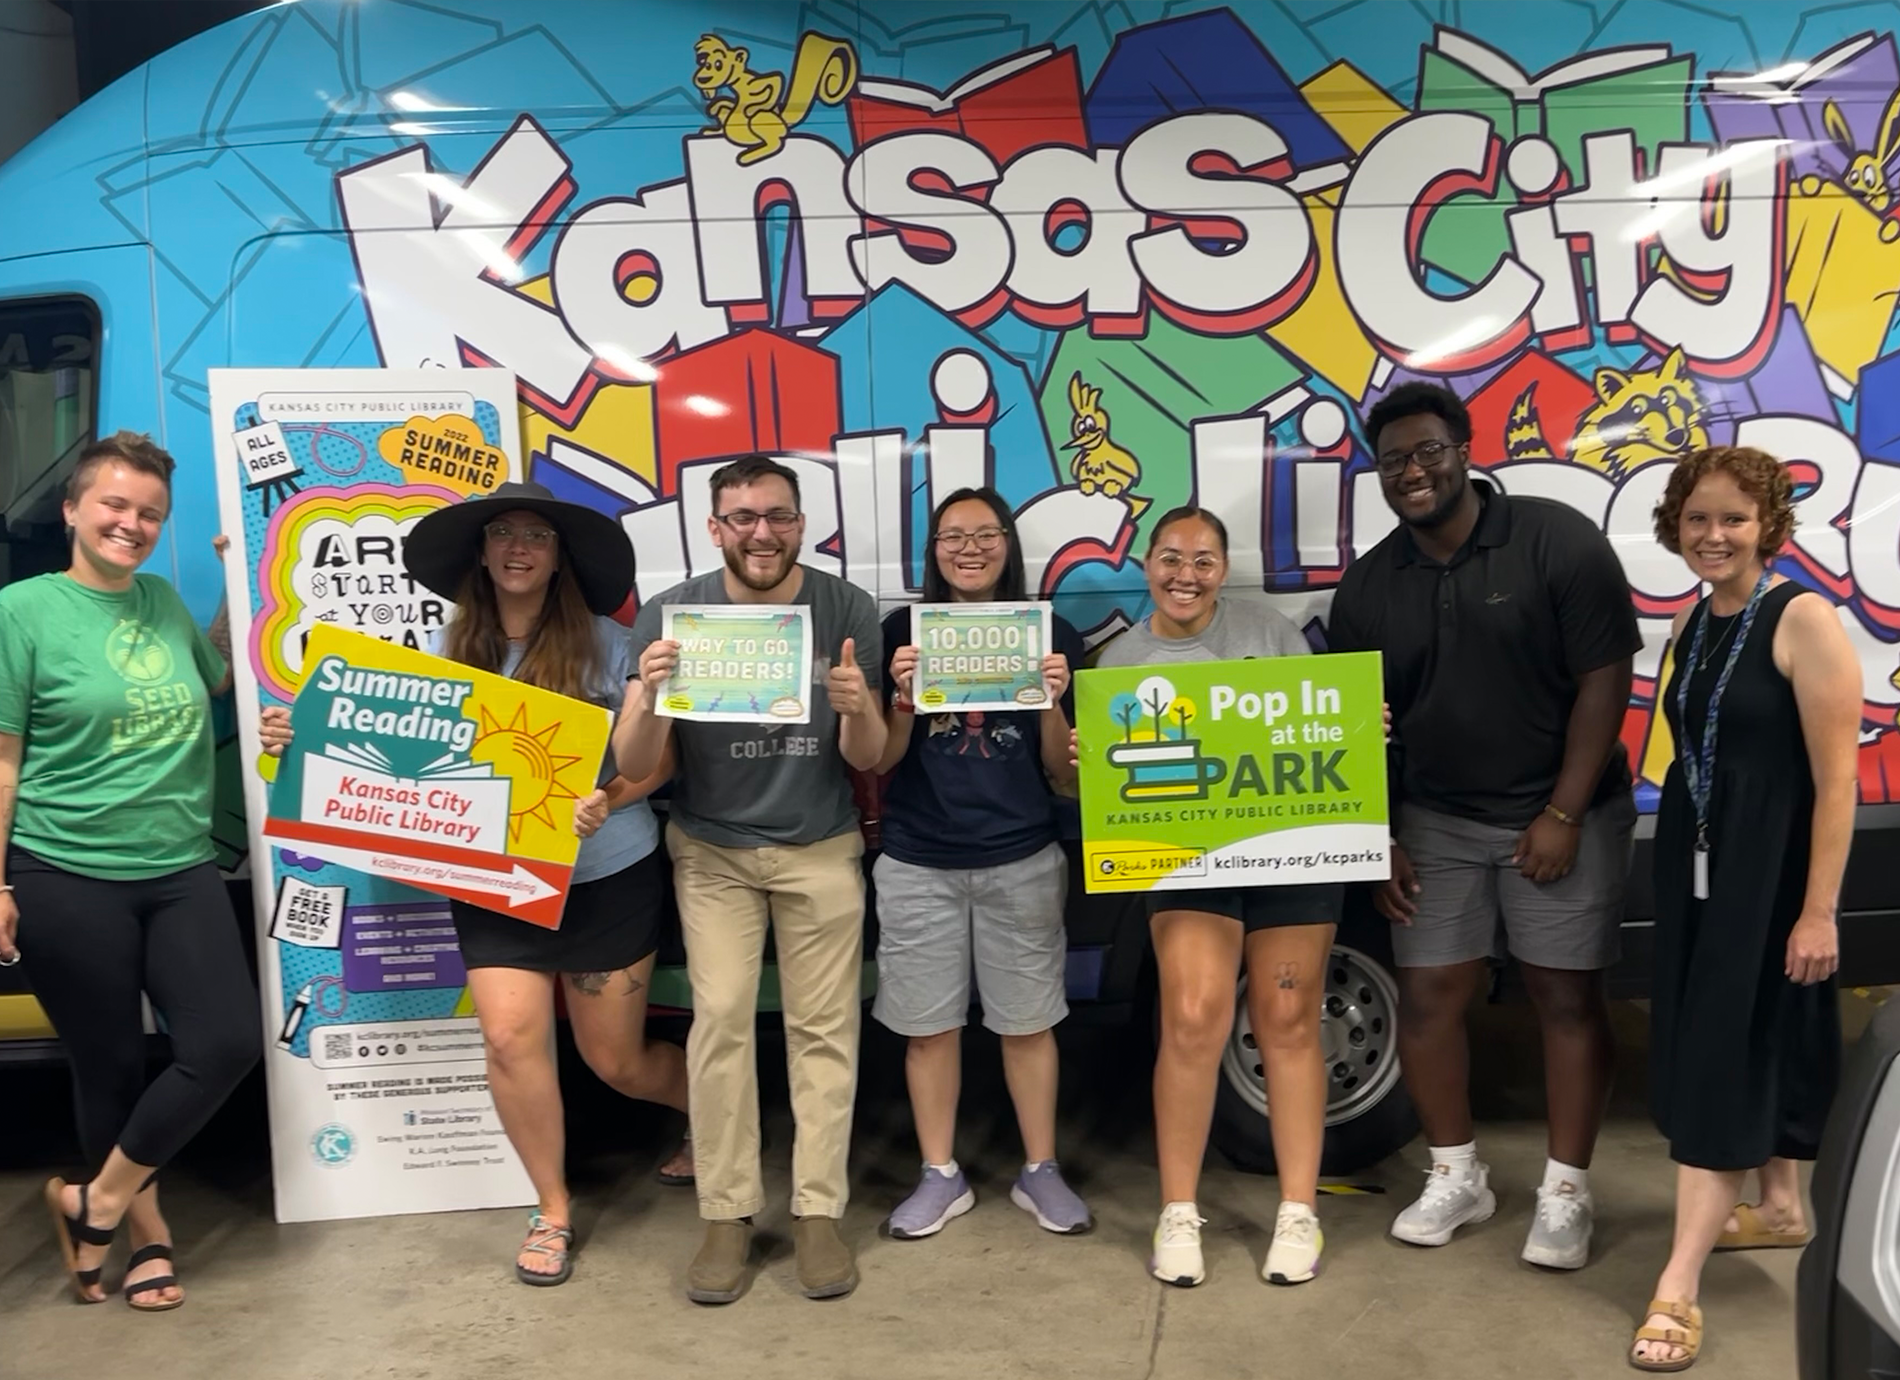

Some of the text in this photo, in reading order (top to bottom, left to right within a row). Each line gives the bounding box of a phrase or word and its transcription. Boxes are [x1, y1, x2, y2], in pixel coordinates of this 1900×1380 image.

[333, 109, 1790, 408] Kansas City
[269, 401, 463, 412] KANSAS CITY PUBLIC LIBRARY
[247, 434, 275, 451] ALL
[443, 428, 469, 442] 2022
[249, 451, 288, 472] AGES
[404, 429, 500, 471] SUMMER
[400, 448, 496, 489] READING
[313, 533, 407, 568] AR
[680, 637, 726, 655] WAY
[733, 638, 758, 656] TO
[679, 660, 795, 681] READERS!
[928, 654, 1023, 675] READERS
[317, 659, 471, 709] Summer
[125, 682, 193, 716] SEED
[1210, 679, 1341, 728] Pop In
[327, 696, 477, 753] Reading
[1270, 721, 1344, 746] at the
[730, 737, 819, 760] COLLEGE
[1200, 749, 1350, 800] PARK
[339, 776, 473, 818] Kansas City
[324, 799, 482, 844] Public Library
[1106, 801, 1363, 826] KANSAS CITY PUBLIC LIBRARY
[1150, 856, 1202, 870] PARTNER
[1214, 850, 1384, 871] kclibrary.org/kcparks
[371, 856, 537, 895] kclibrary.org/summerreading
[289, 896, 334, 915] FREE
[287, 909, 329, 928] BOOK
